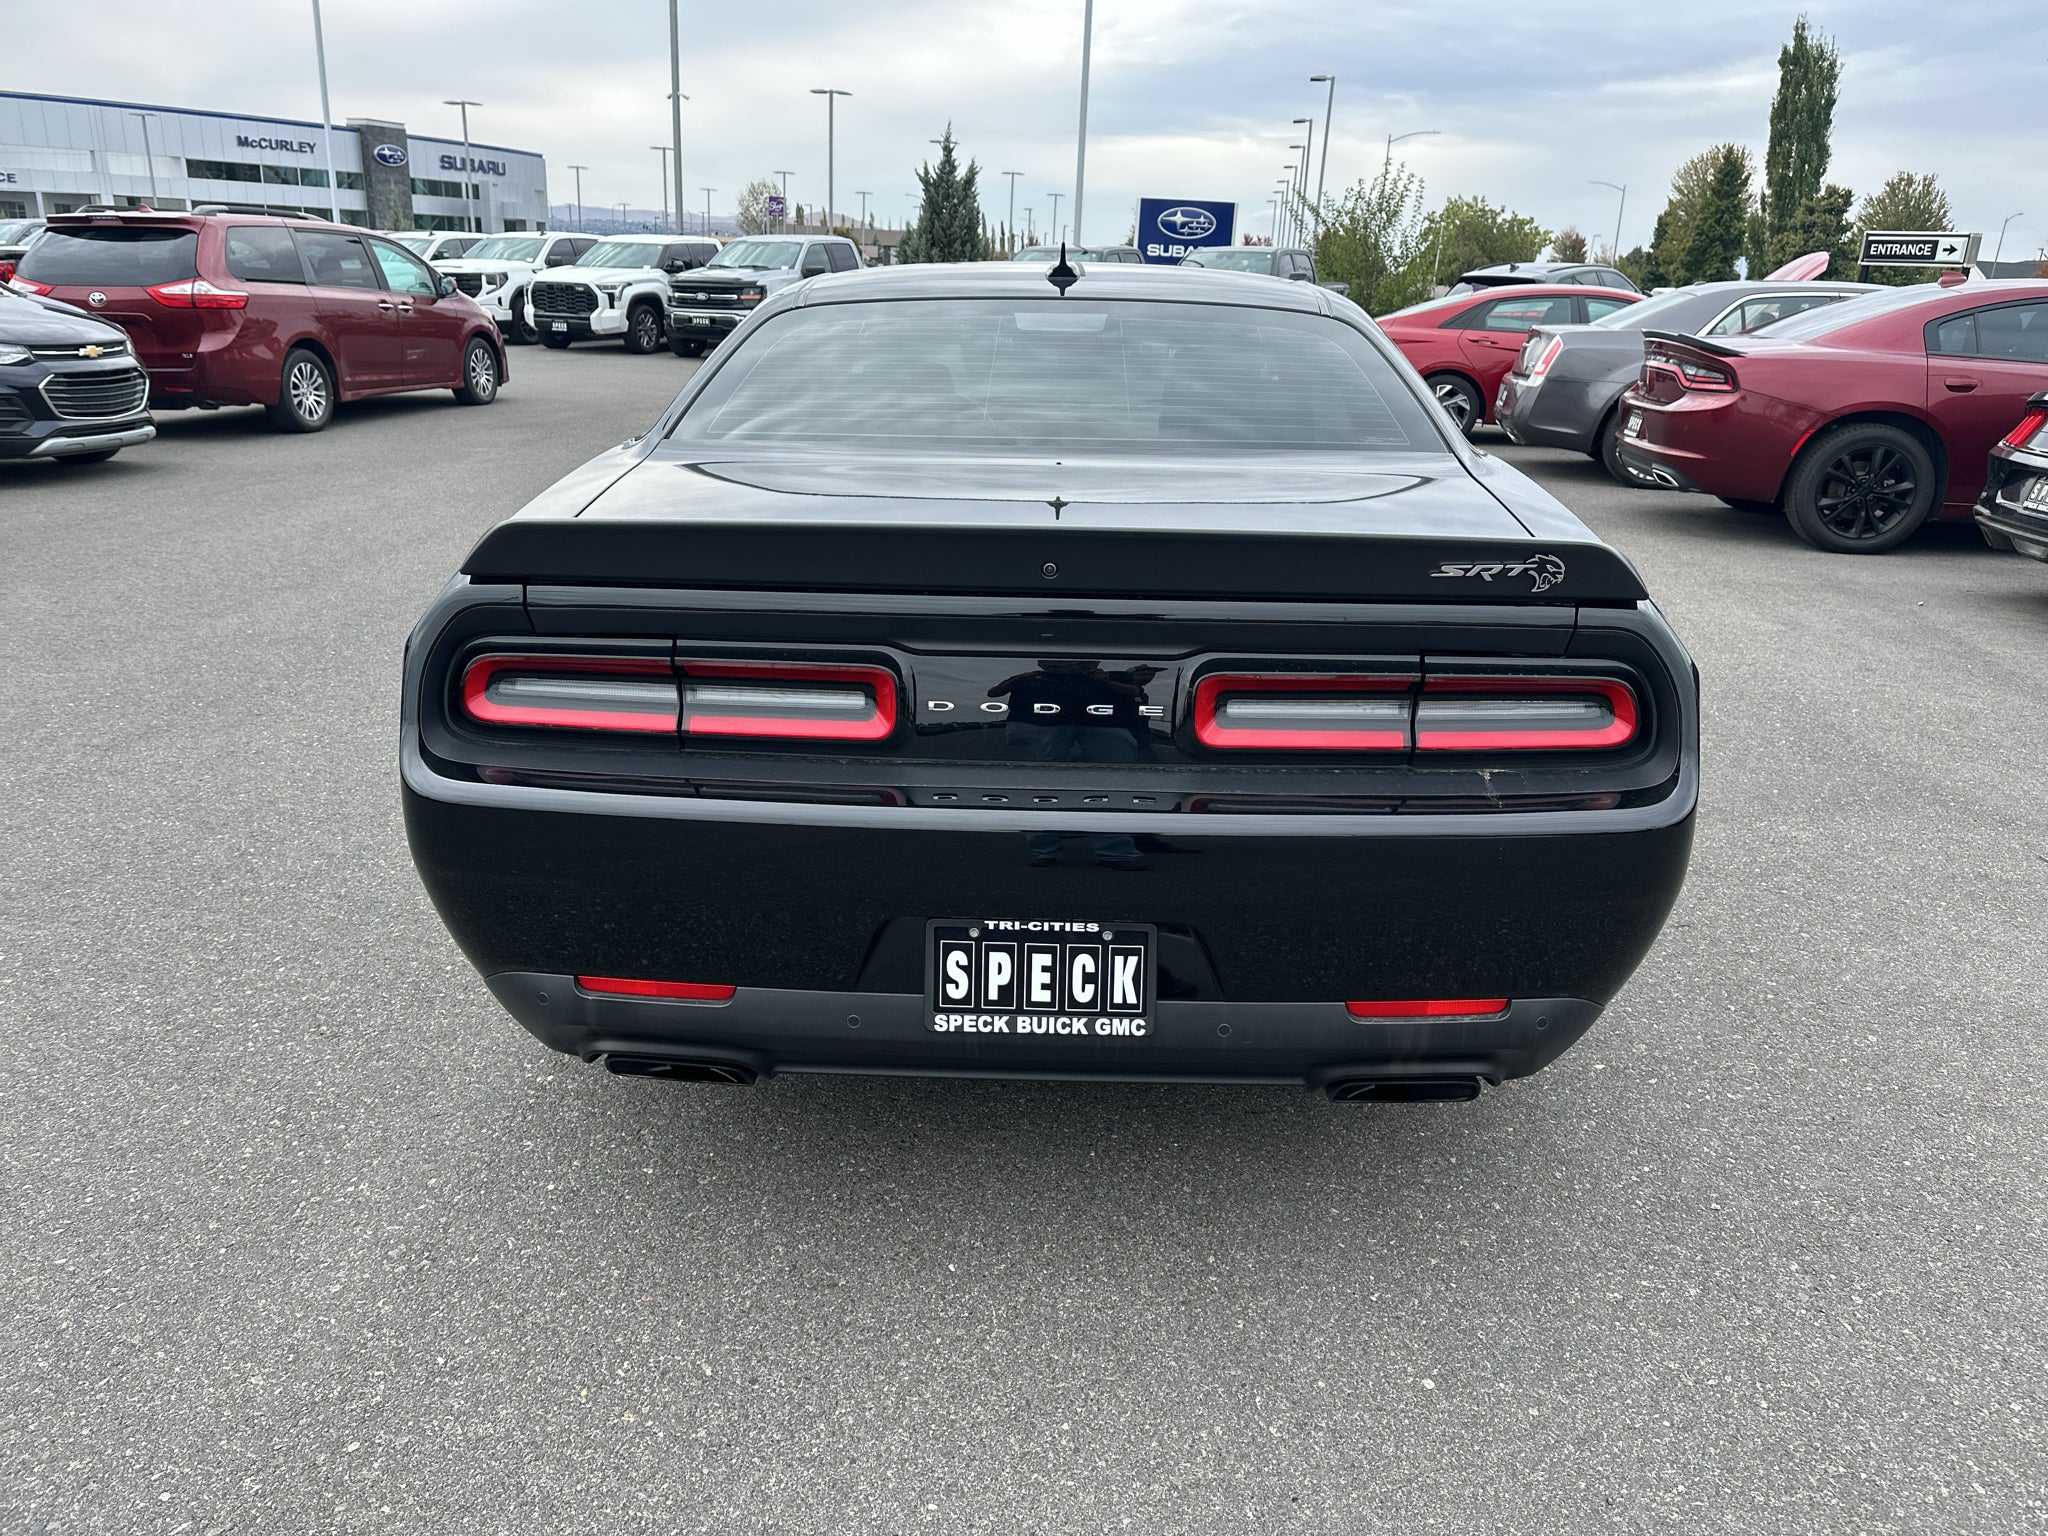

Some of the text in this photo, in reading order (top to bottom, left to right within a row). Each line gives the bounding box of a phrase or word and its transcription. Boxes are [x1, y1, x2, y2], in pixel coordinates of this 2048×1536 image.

[236, 135, 316, 154] McCURLEY
[1869, 243, 1933, 256] ENTRANCE
[2030, 483, 2048, 502] SP
[1430, 564, 1538, 581] SRT
[928, 700, 1164, 716] DODGE
[984, 920, 1100, 932] TRI-CITIES
[945, 950, 1139, 1004] SPECK
[934, 1014, 1147, 1036] SPECK BUICK GMC
